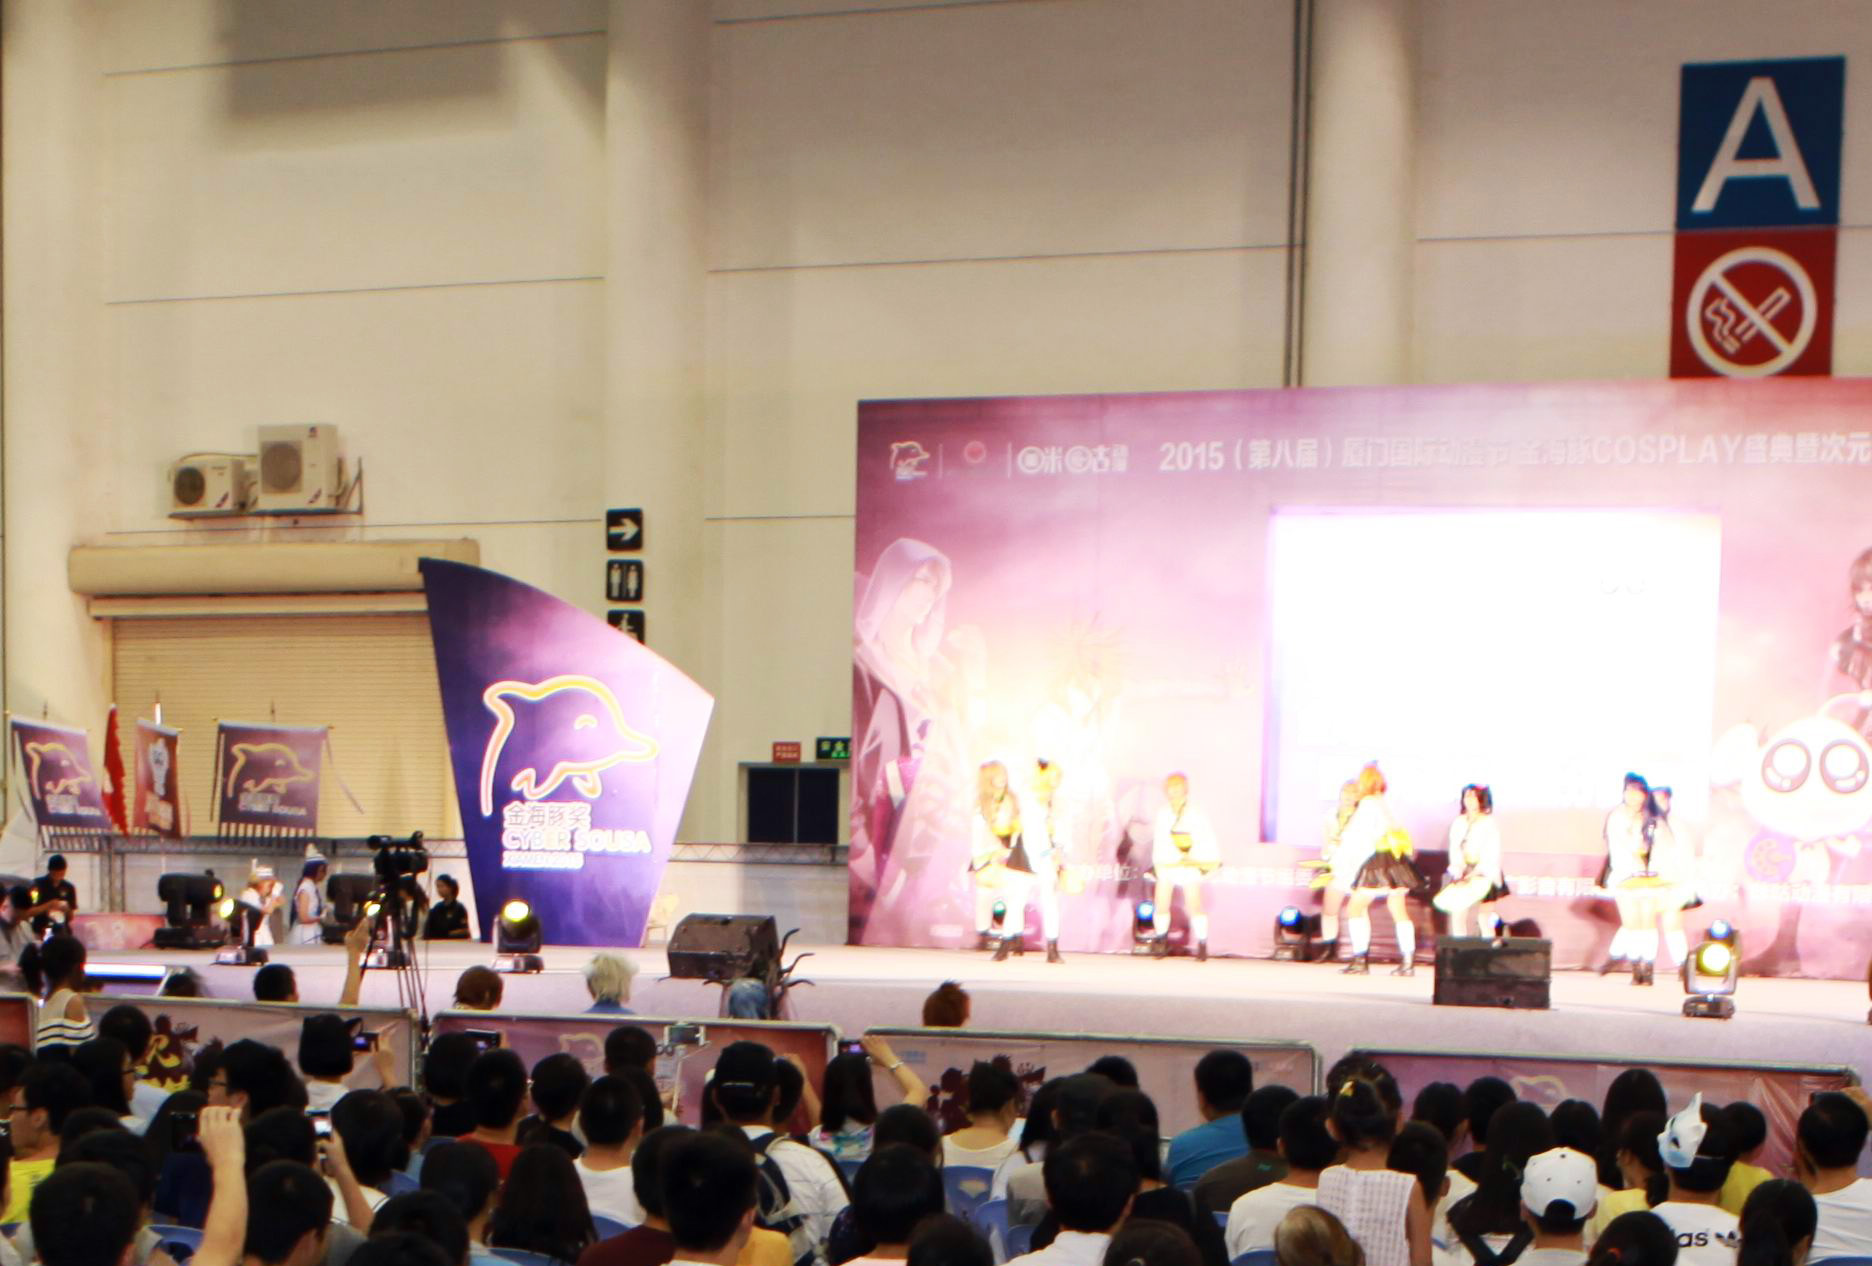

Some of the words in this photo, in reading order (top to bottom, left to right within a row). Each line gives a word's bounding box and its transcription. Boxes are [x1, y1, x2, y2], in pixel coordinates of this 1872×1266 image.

[1691, 76, 1820, 211] A
[503, 830, 572, 852] CYBER
[575, 831, 653, 854] SOUSA
